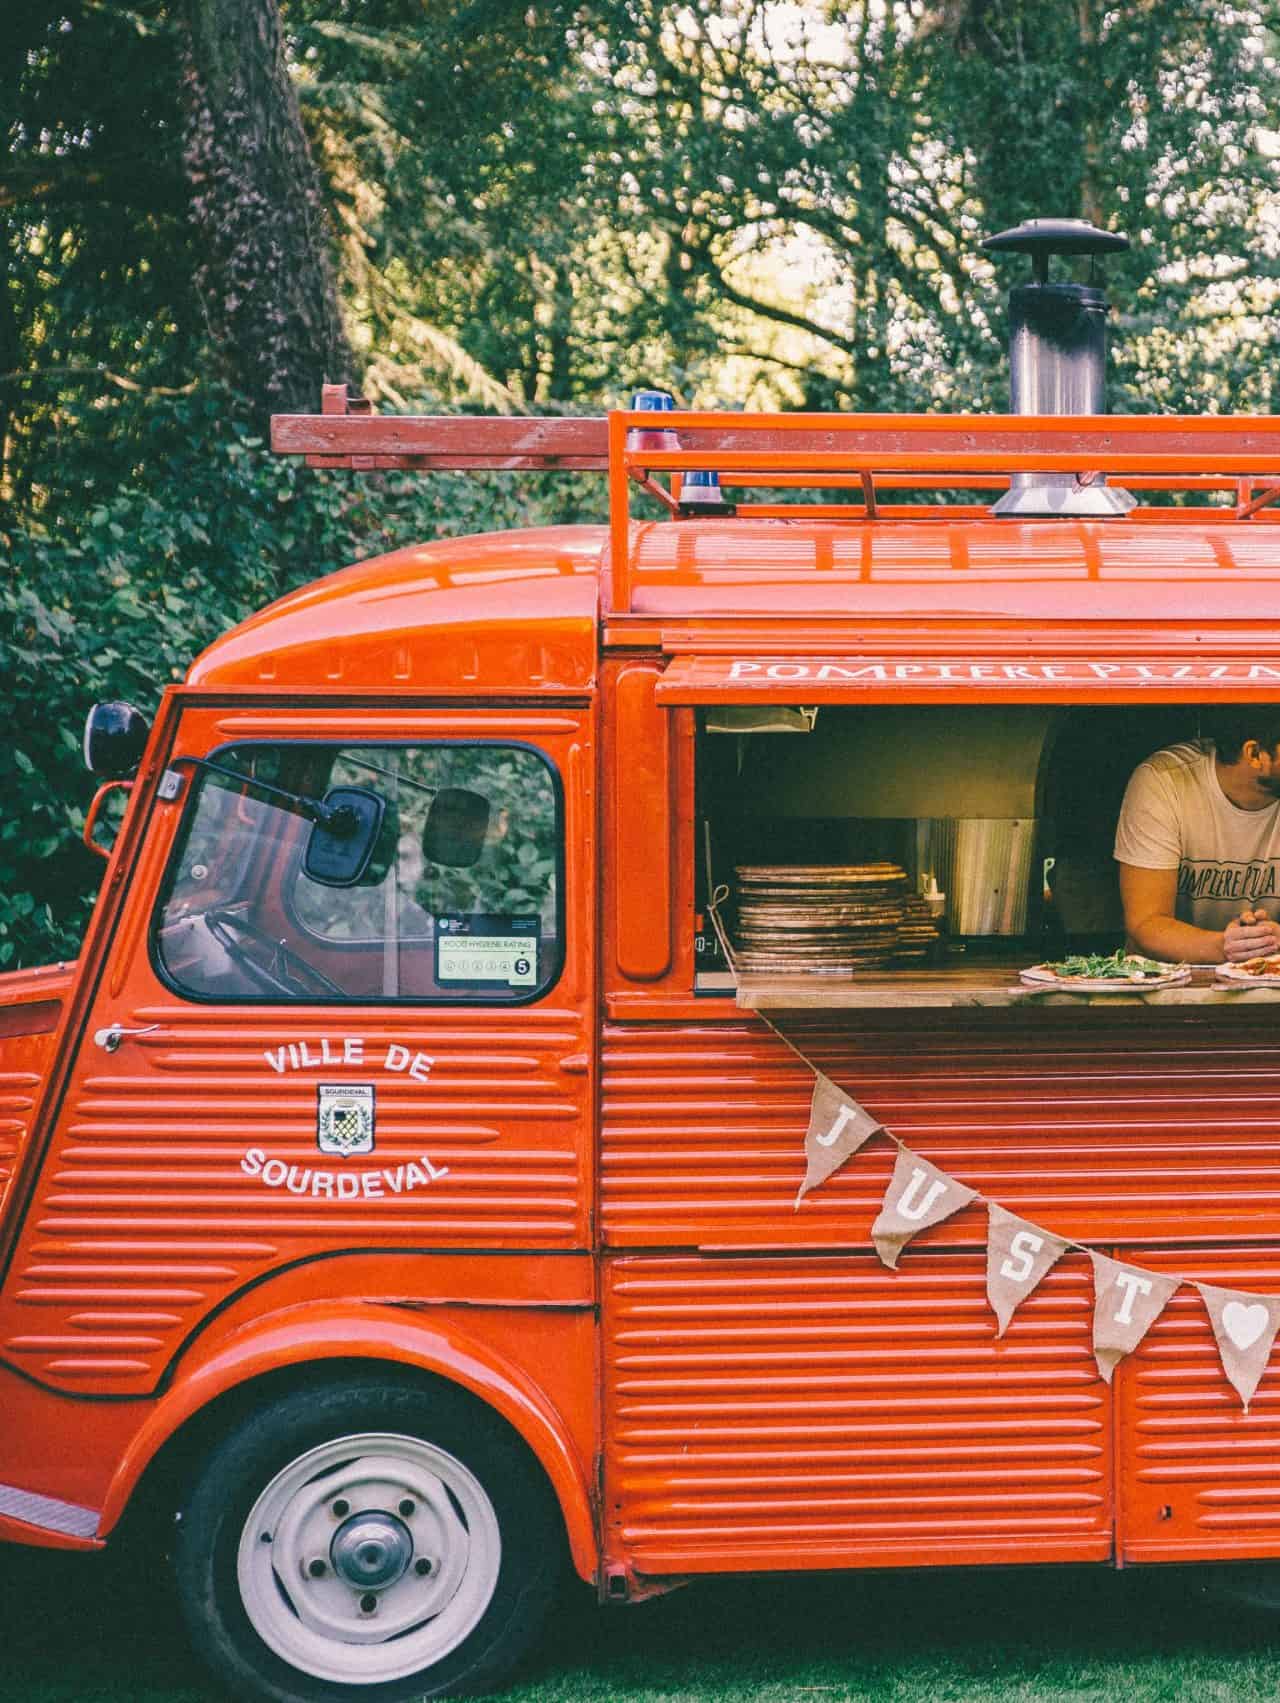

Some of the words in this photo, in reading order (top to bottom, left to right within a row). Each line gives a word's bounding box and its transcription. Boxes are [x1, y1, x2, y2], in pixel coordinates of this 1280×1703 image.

[728, 661, 1071, 680] POMPIERE
[503, 940, 532, 949] RATING
[264, 1038, 365, 1073] VILLE
[384, 1044, 435, 1082] DE
[240, 1148, 449, 1199] SOURDEVAL
[816, 1104, 1153, 1325] JUST
